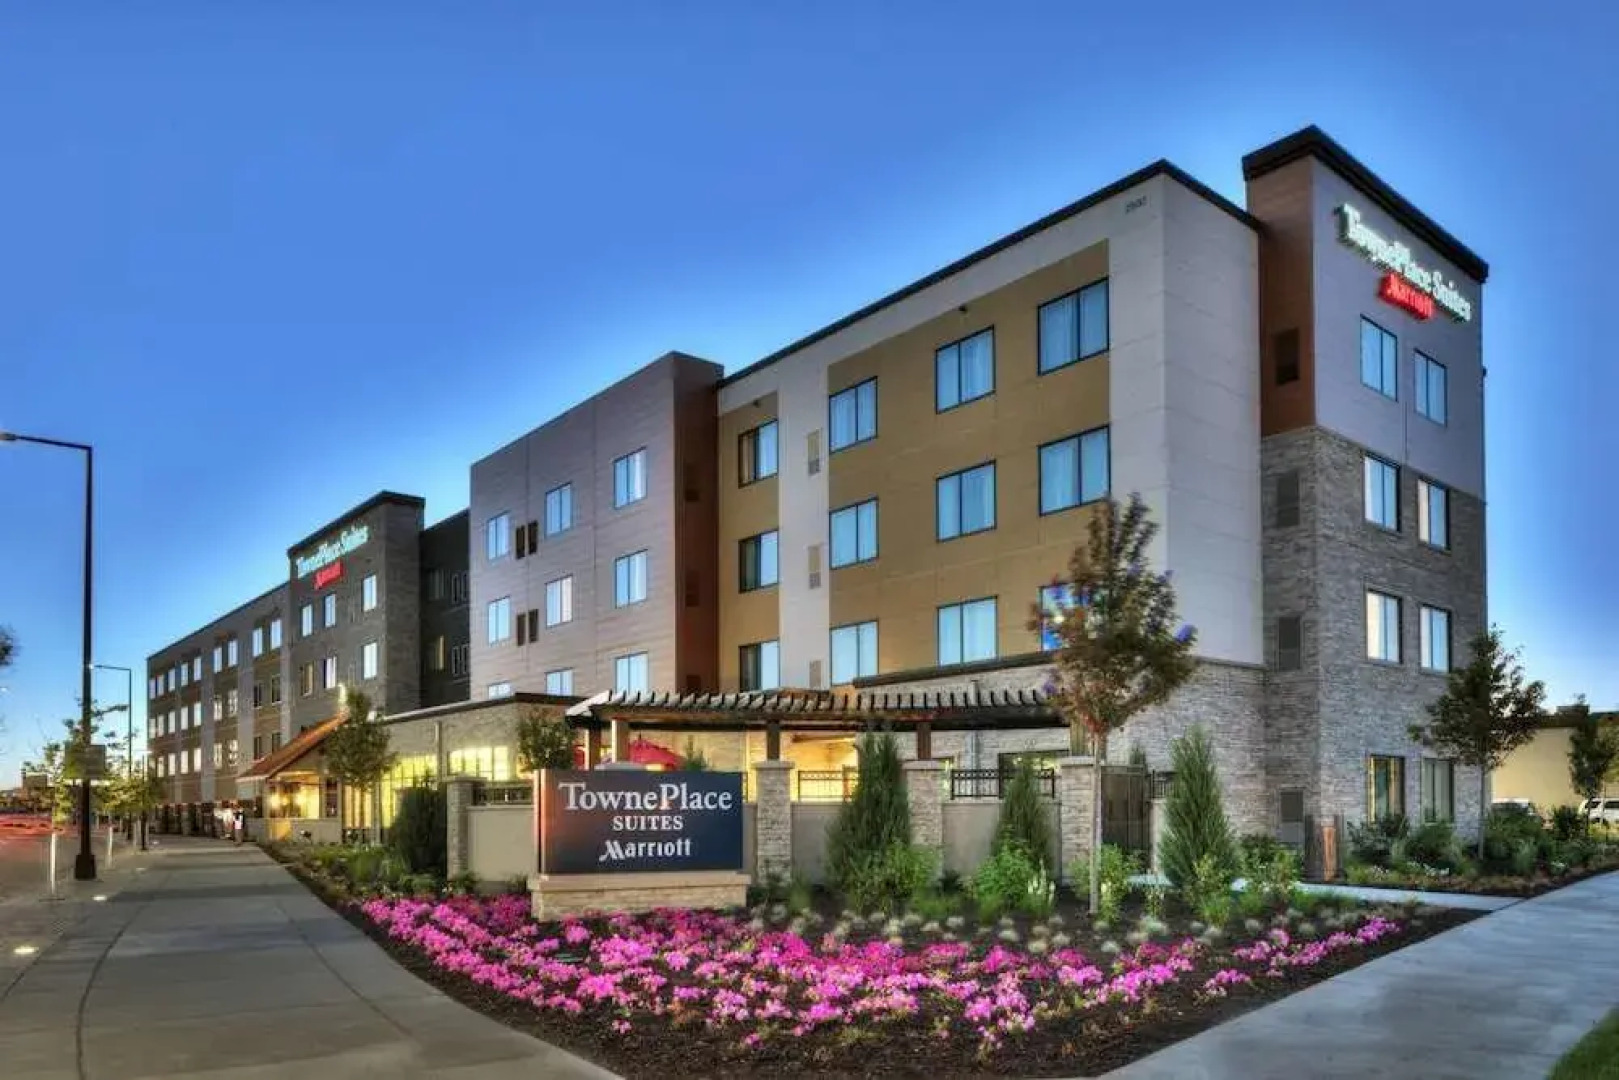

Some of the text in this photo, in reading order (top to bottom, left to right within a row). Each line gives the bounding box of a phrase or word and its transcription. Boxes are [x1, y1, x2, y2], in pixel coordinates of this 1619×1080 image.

[1431, 270, 1472, 322] Suites
[558, 781, 733, 811] TownePlace
[611, 815, 684, 831] SUITES
[599, 837, 692, 862] Marriott
